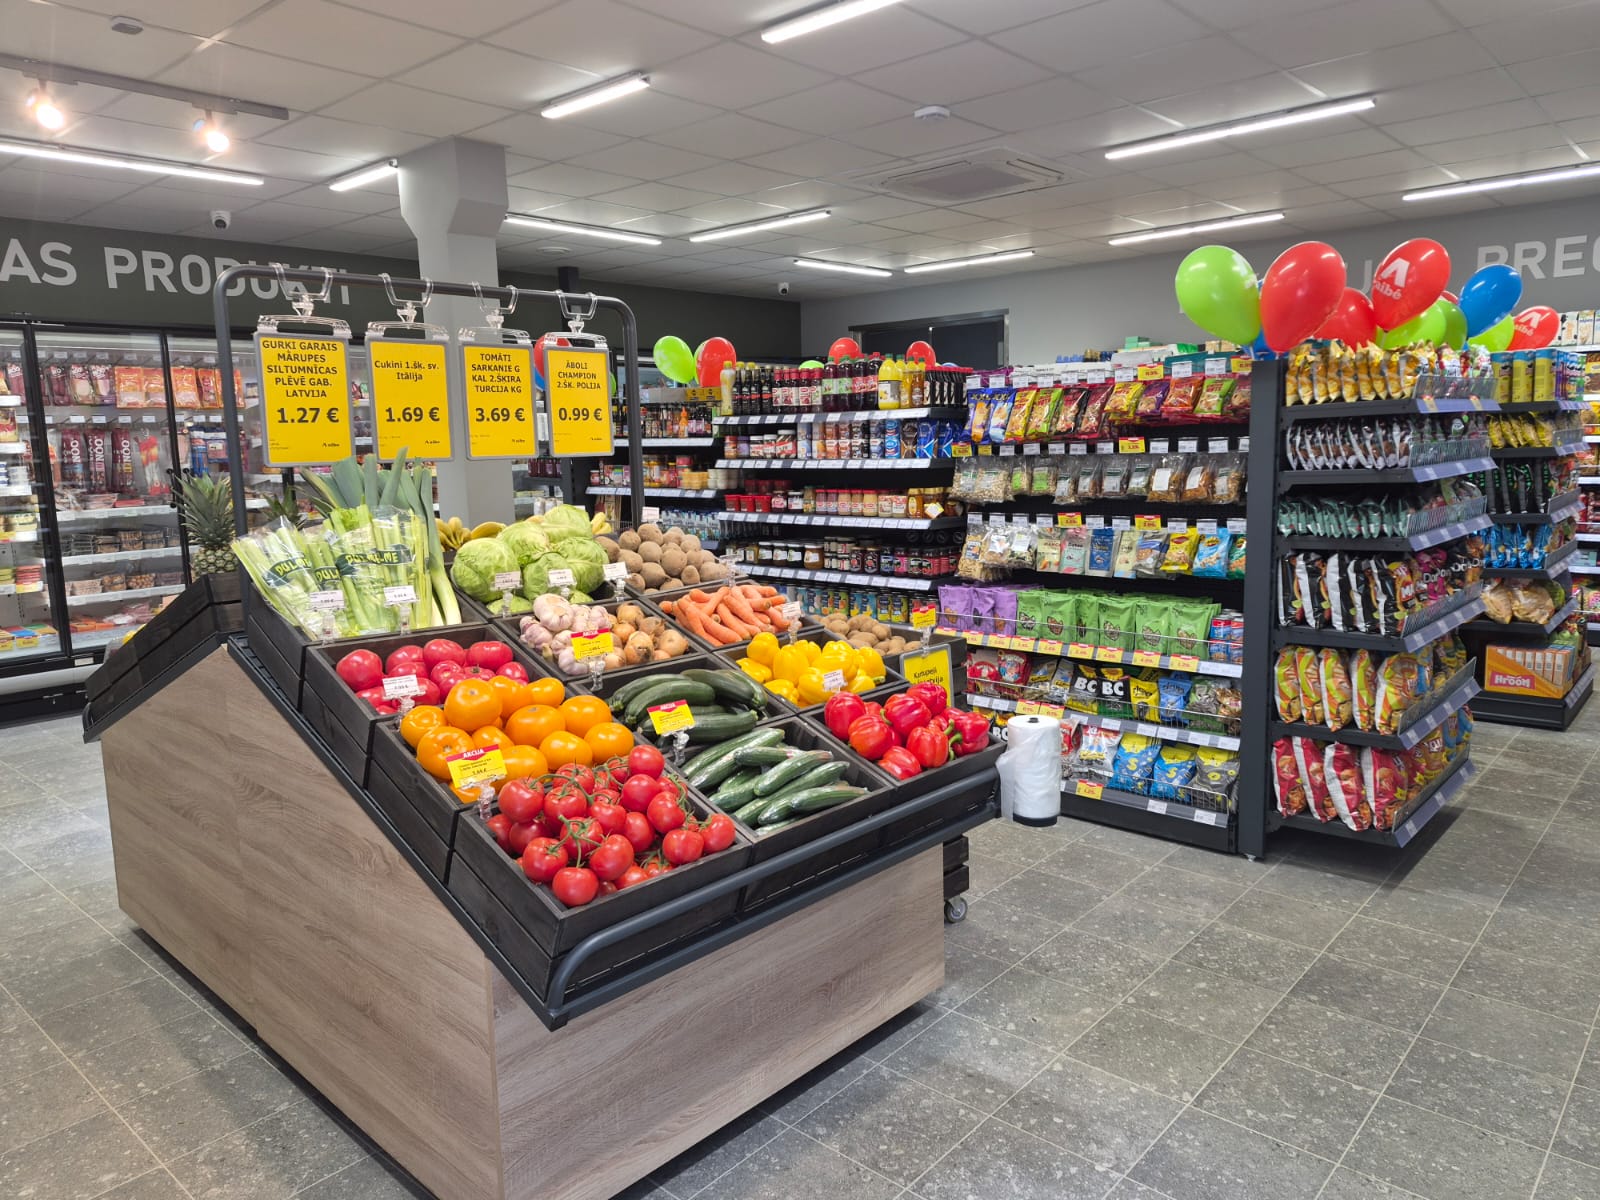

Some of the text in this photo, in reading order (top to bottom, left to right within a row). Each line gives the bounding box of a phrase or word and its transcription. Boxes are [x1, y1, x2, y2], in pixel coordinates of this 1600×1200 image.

[1477, 234, 1600, 280] PRE
[299, 341, 338, 351] GARAIS
[277, 351, 326, 363] MĀRUPES
[479, 352, 512, 362] TOMĀTI
[267, 364, 338, 375] SILTUMNĪCAS
[374, 360, 403, 369] Cukini
[471, 363, 521, 373] SARKANIE G
[566, 360, 588, 370] ĀBOLI
[275, 375, 332, 387] PLĒVĒ GAB.
[396, 371, 423, 383] Itālija
[472, 374, 488, 383] KAL
[557, 371, 597, 380] CHAMPION
[475, 385, 522, 394] TURCIJA KG
[576, 382, 601, 390] POLIJA
[286, 389, 327, 398] LATVIJA
[277, 407, 340, 424] 1.27 €
[385, 406, 441, 423] 1.69 €
[475, 407, 526, 423] 3.69 €
[558, 407, 604, 422] 0.99 €
[1074, 676, 1098, 693] BC
[1101, 680, 1124, 696] BC
